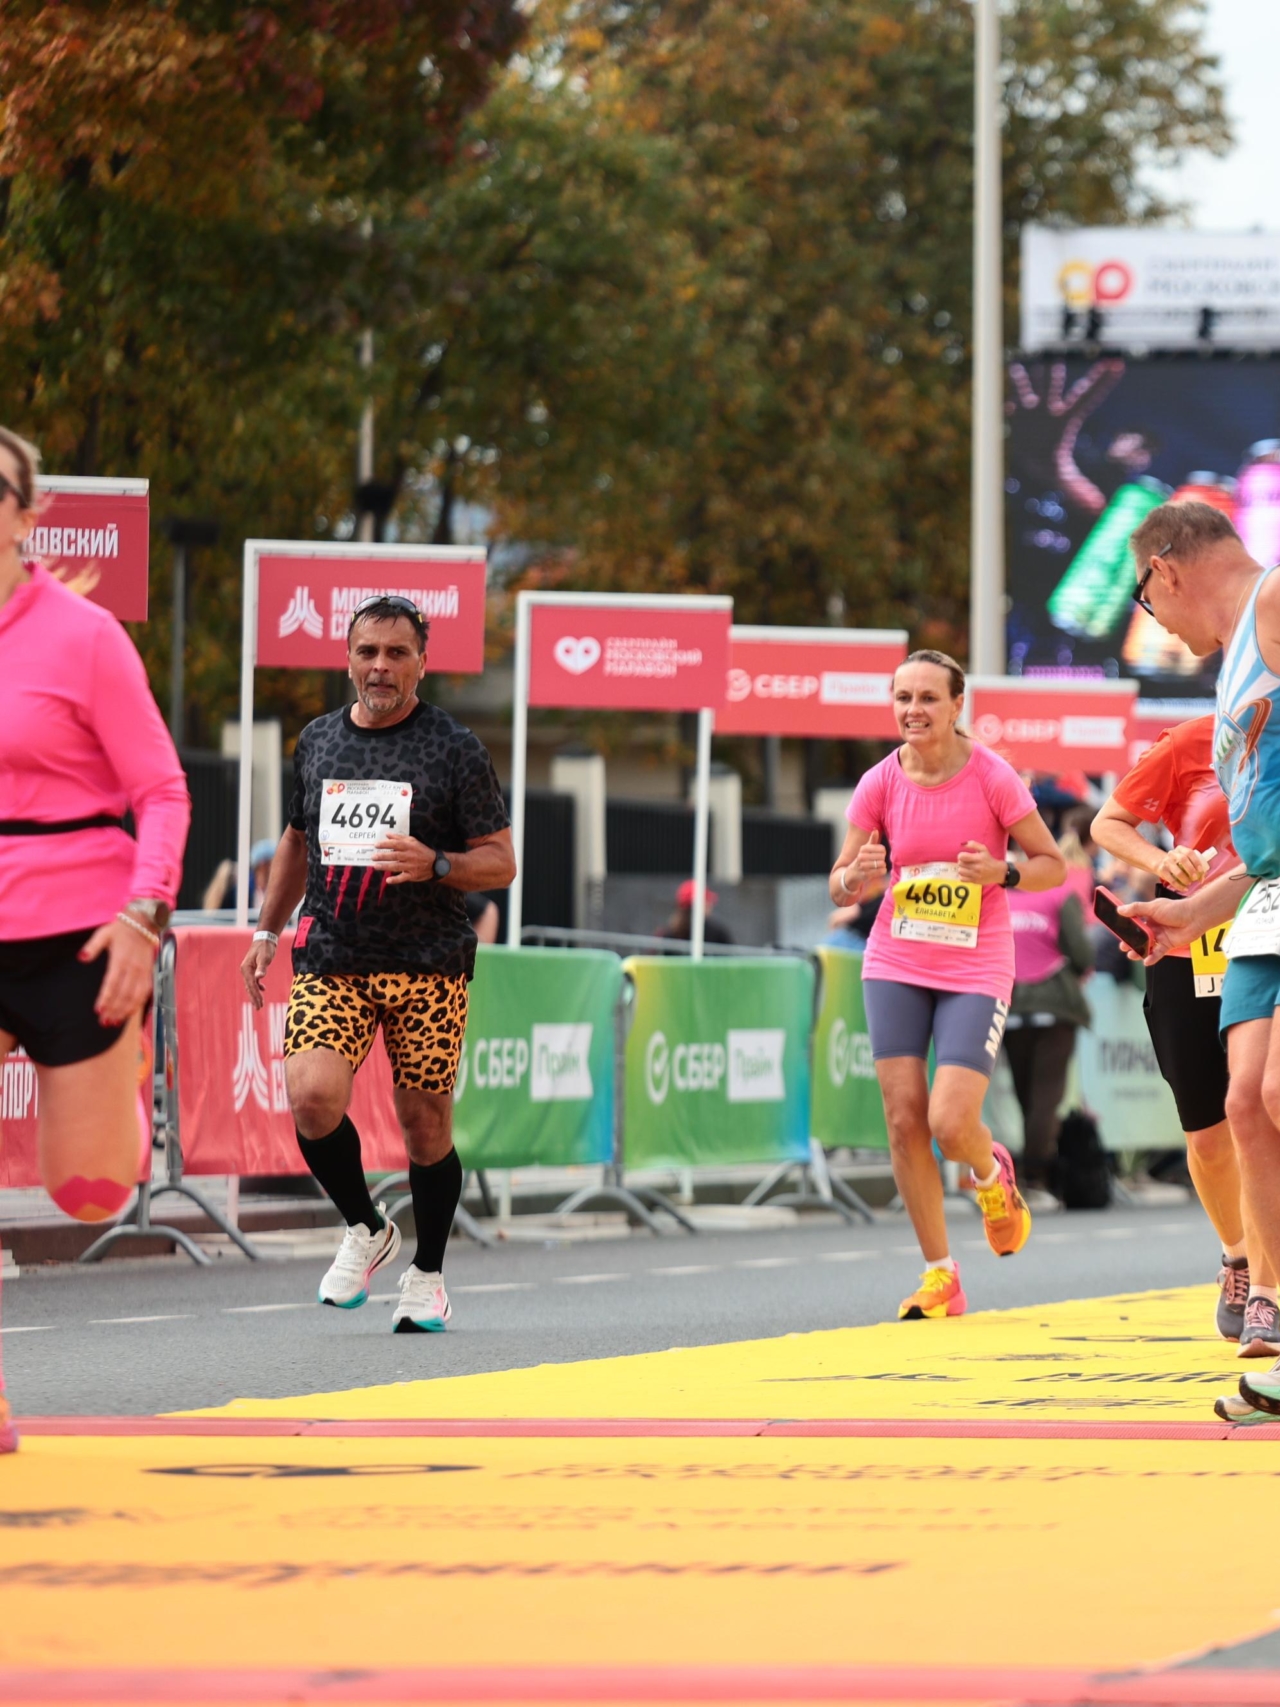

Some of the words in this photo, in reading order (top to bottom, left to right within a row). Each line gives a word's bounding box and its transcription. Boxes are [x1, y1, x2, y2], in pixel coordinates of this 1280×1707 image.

[22, 523, 118, 558] КОВСКИЙ
[331, 586, 459, 618] МОСКИЙ
[605, 648, 702, 667] МОСКОВСКИЙ
[753, 674, 820, 699] СБЕР
[331, 803, 396, 829] 4694
[349, 831, 376, 839] СЕРГЕЙ
[905, 883, 970, 909] 4609
[915, 907, 956, 919] ЕЛИЗАВЕТА
[1200, 928, 1226, 956] 14
[473, 1037, 530, 1089] СБЕР
[672, 1042, 727, 1091] СБЕР
